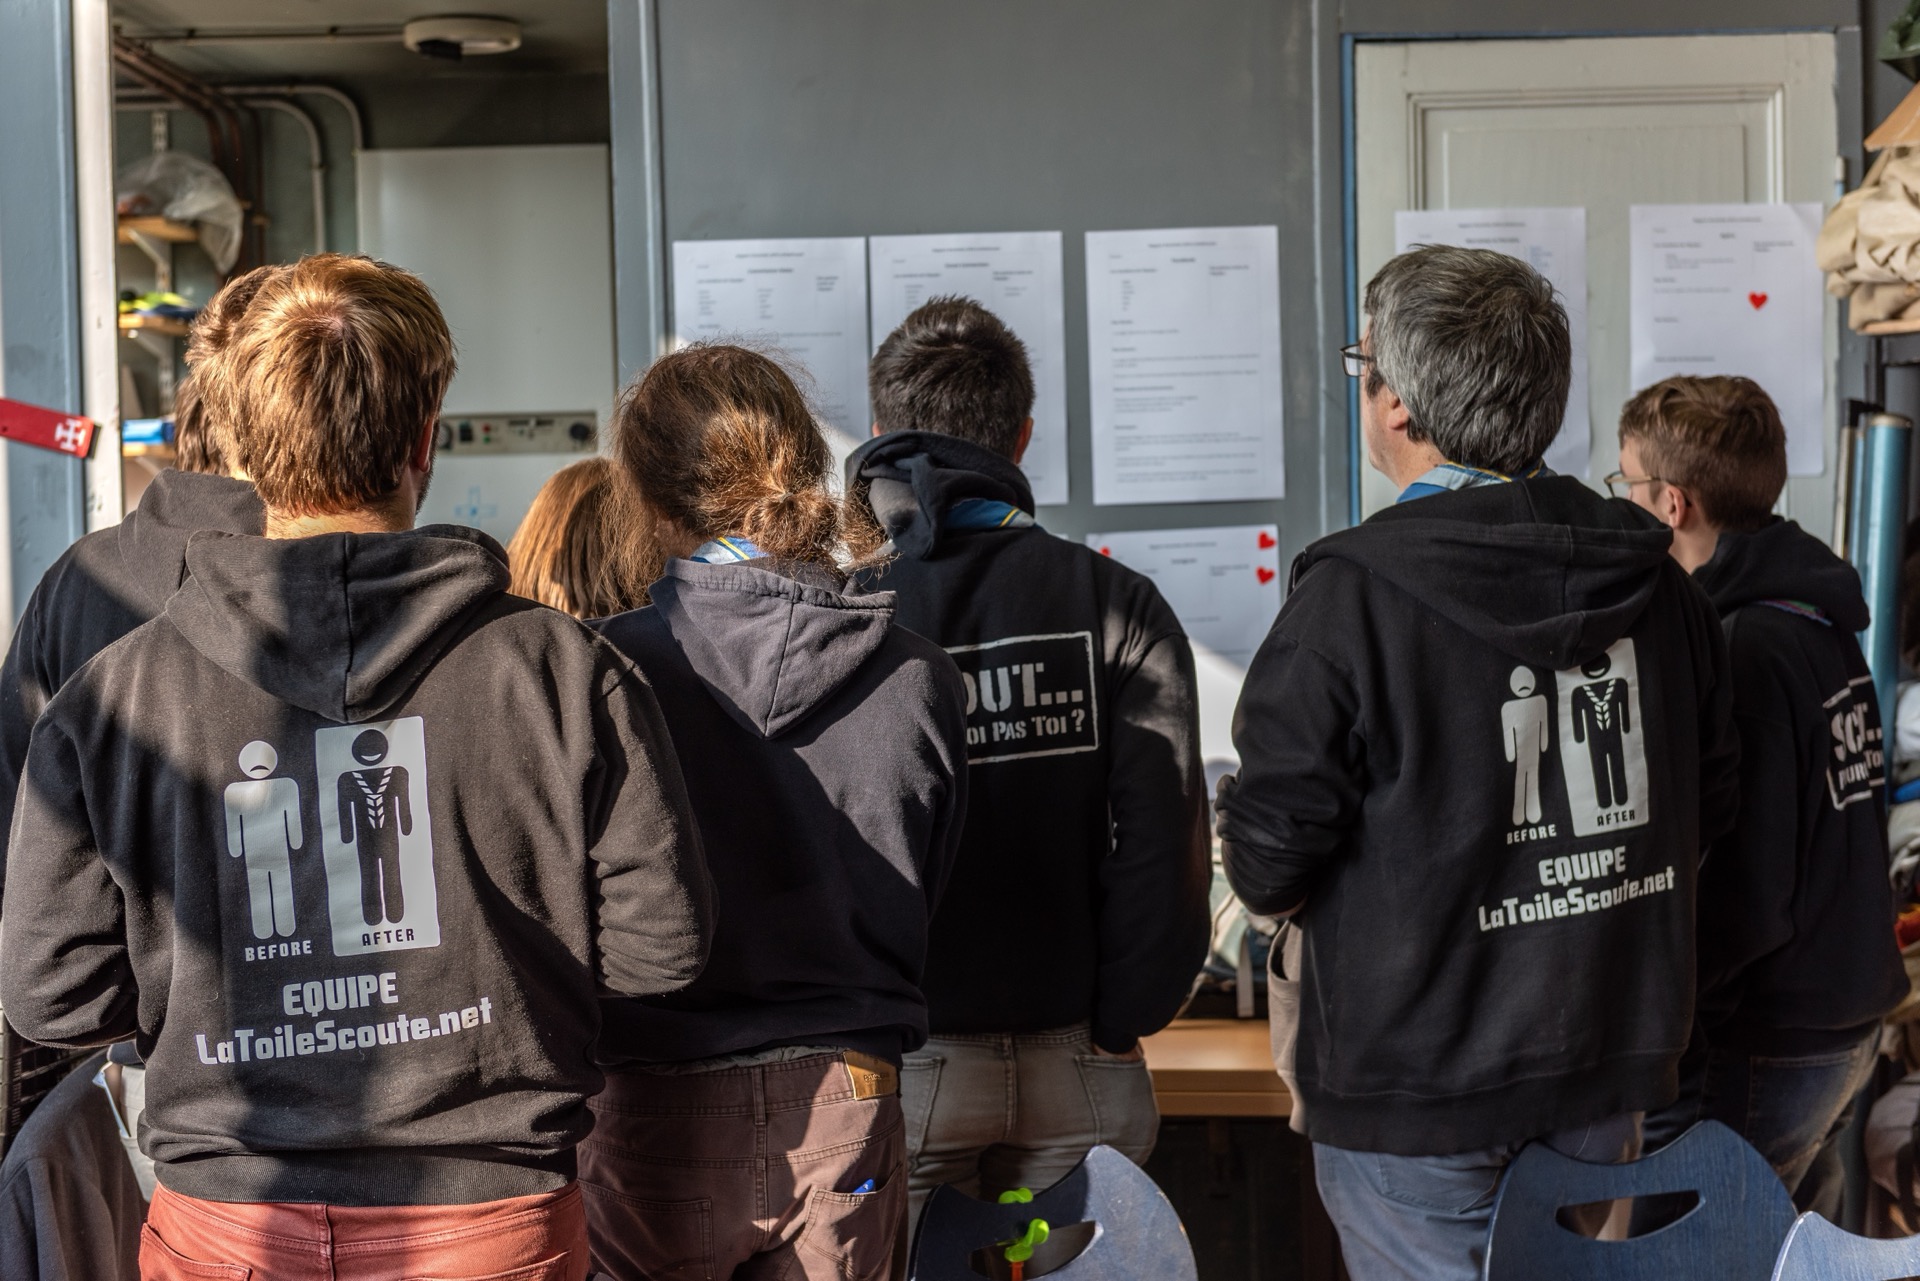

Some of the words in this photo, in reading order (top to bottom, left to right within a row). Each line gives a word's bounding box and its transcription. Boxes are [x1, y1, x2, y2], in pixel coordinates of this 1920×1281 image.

[1071, 708, 1085, 732] ?
[1597, 809, 1636, 827] AFTER
[1506, 824, 1557, 845] BEFORE
[1538, 846, 1626, 887] EQUIPE
[1478, 866, 1675, 932] LaToileScoute.net
[362, 928, 415, 947] AFTER
[245, 940, 312, 962] BEFORE
[282, 972, 399, 1018] EQUIPE
[195, 996, 492, 1065] LaToileScoute.net
